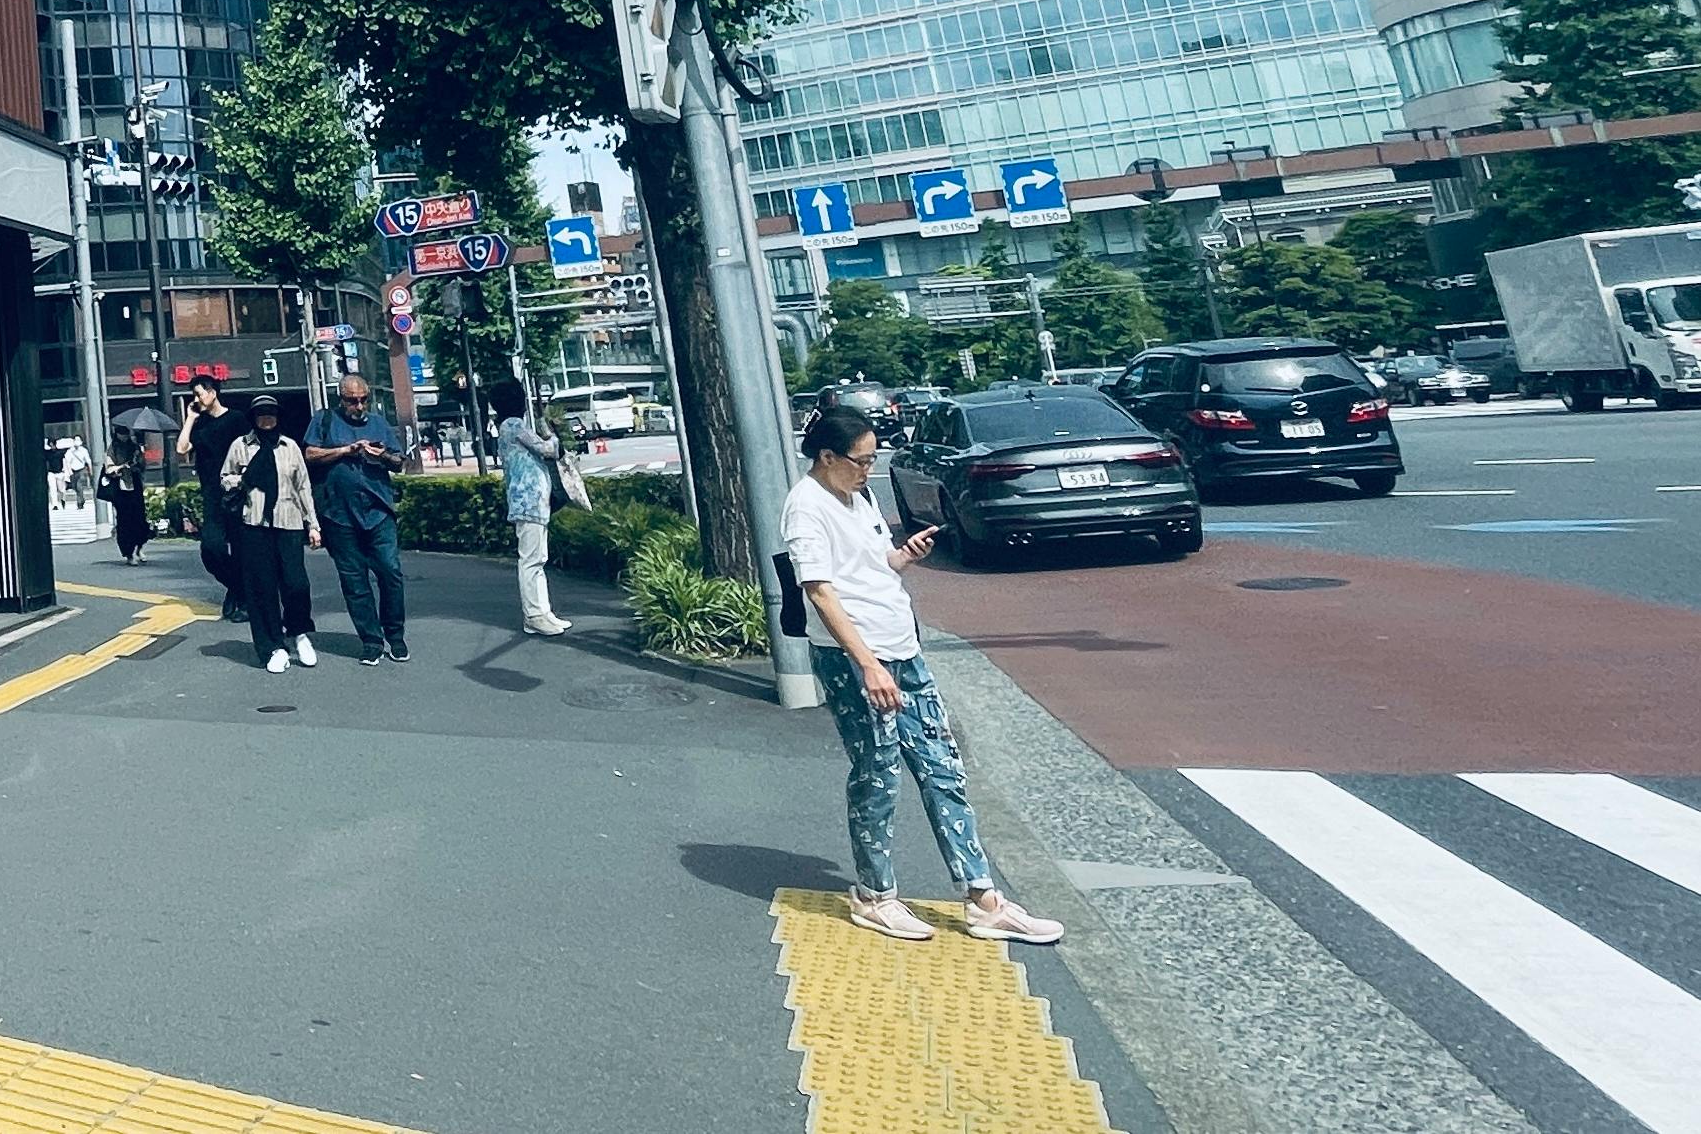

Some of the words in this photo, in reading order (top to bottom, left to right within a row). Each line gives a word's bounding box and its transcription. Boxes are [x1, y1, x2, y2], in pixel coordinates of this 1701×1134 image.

[395, 204, 418, 227] 15
[425, 197, 472, 217] 中央通り
[465, 239, 487, 262] 15
